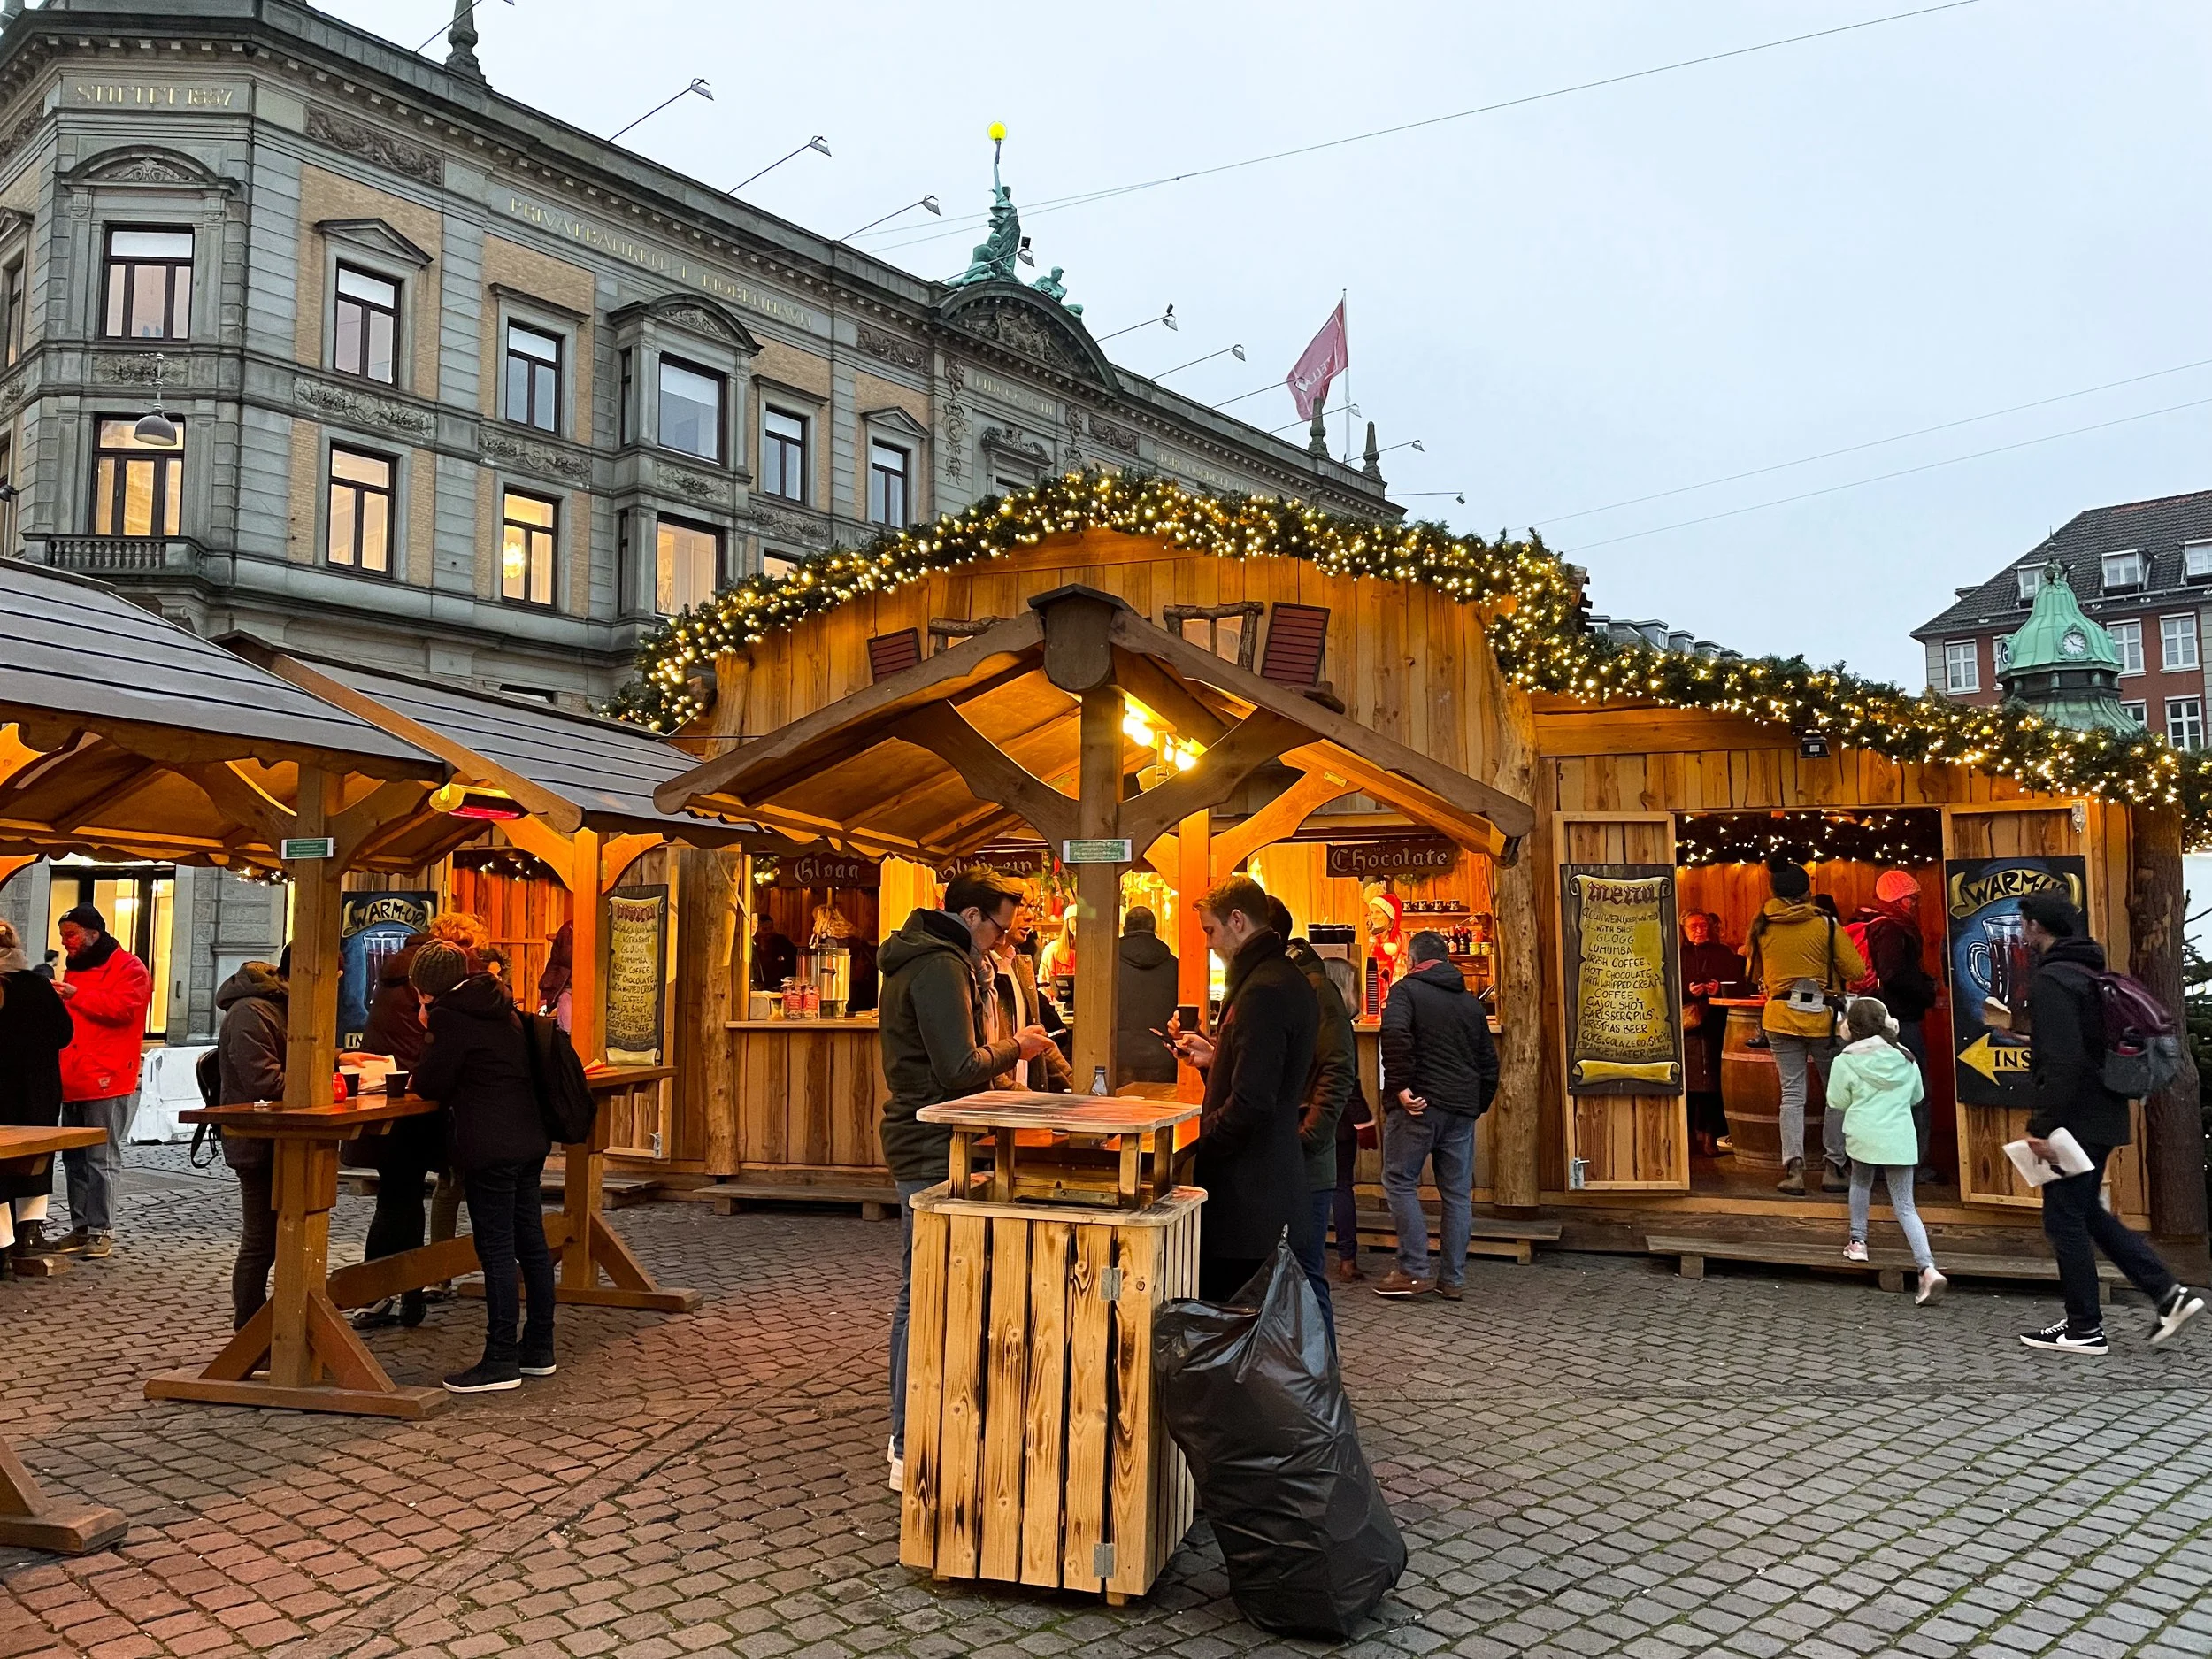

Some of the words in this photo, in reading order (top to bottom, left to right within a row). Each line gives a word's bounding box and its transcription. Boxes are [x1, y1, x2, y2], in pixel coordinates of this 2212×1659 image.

[510, 196, 664, 271] PRIVATBANKEN
[1330, 847, 1448, 873] Chocolate
[1962, 870, 2064, 906] WARM-
[350, 901, 426, 929] WARM-UP
[1588, 942, 1633, 955] LUMUMBA
[1584, 964, 1603, 976] HOT
